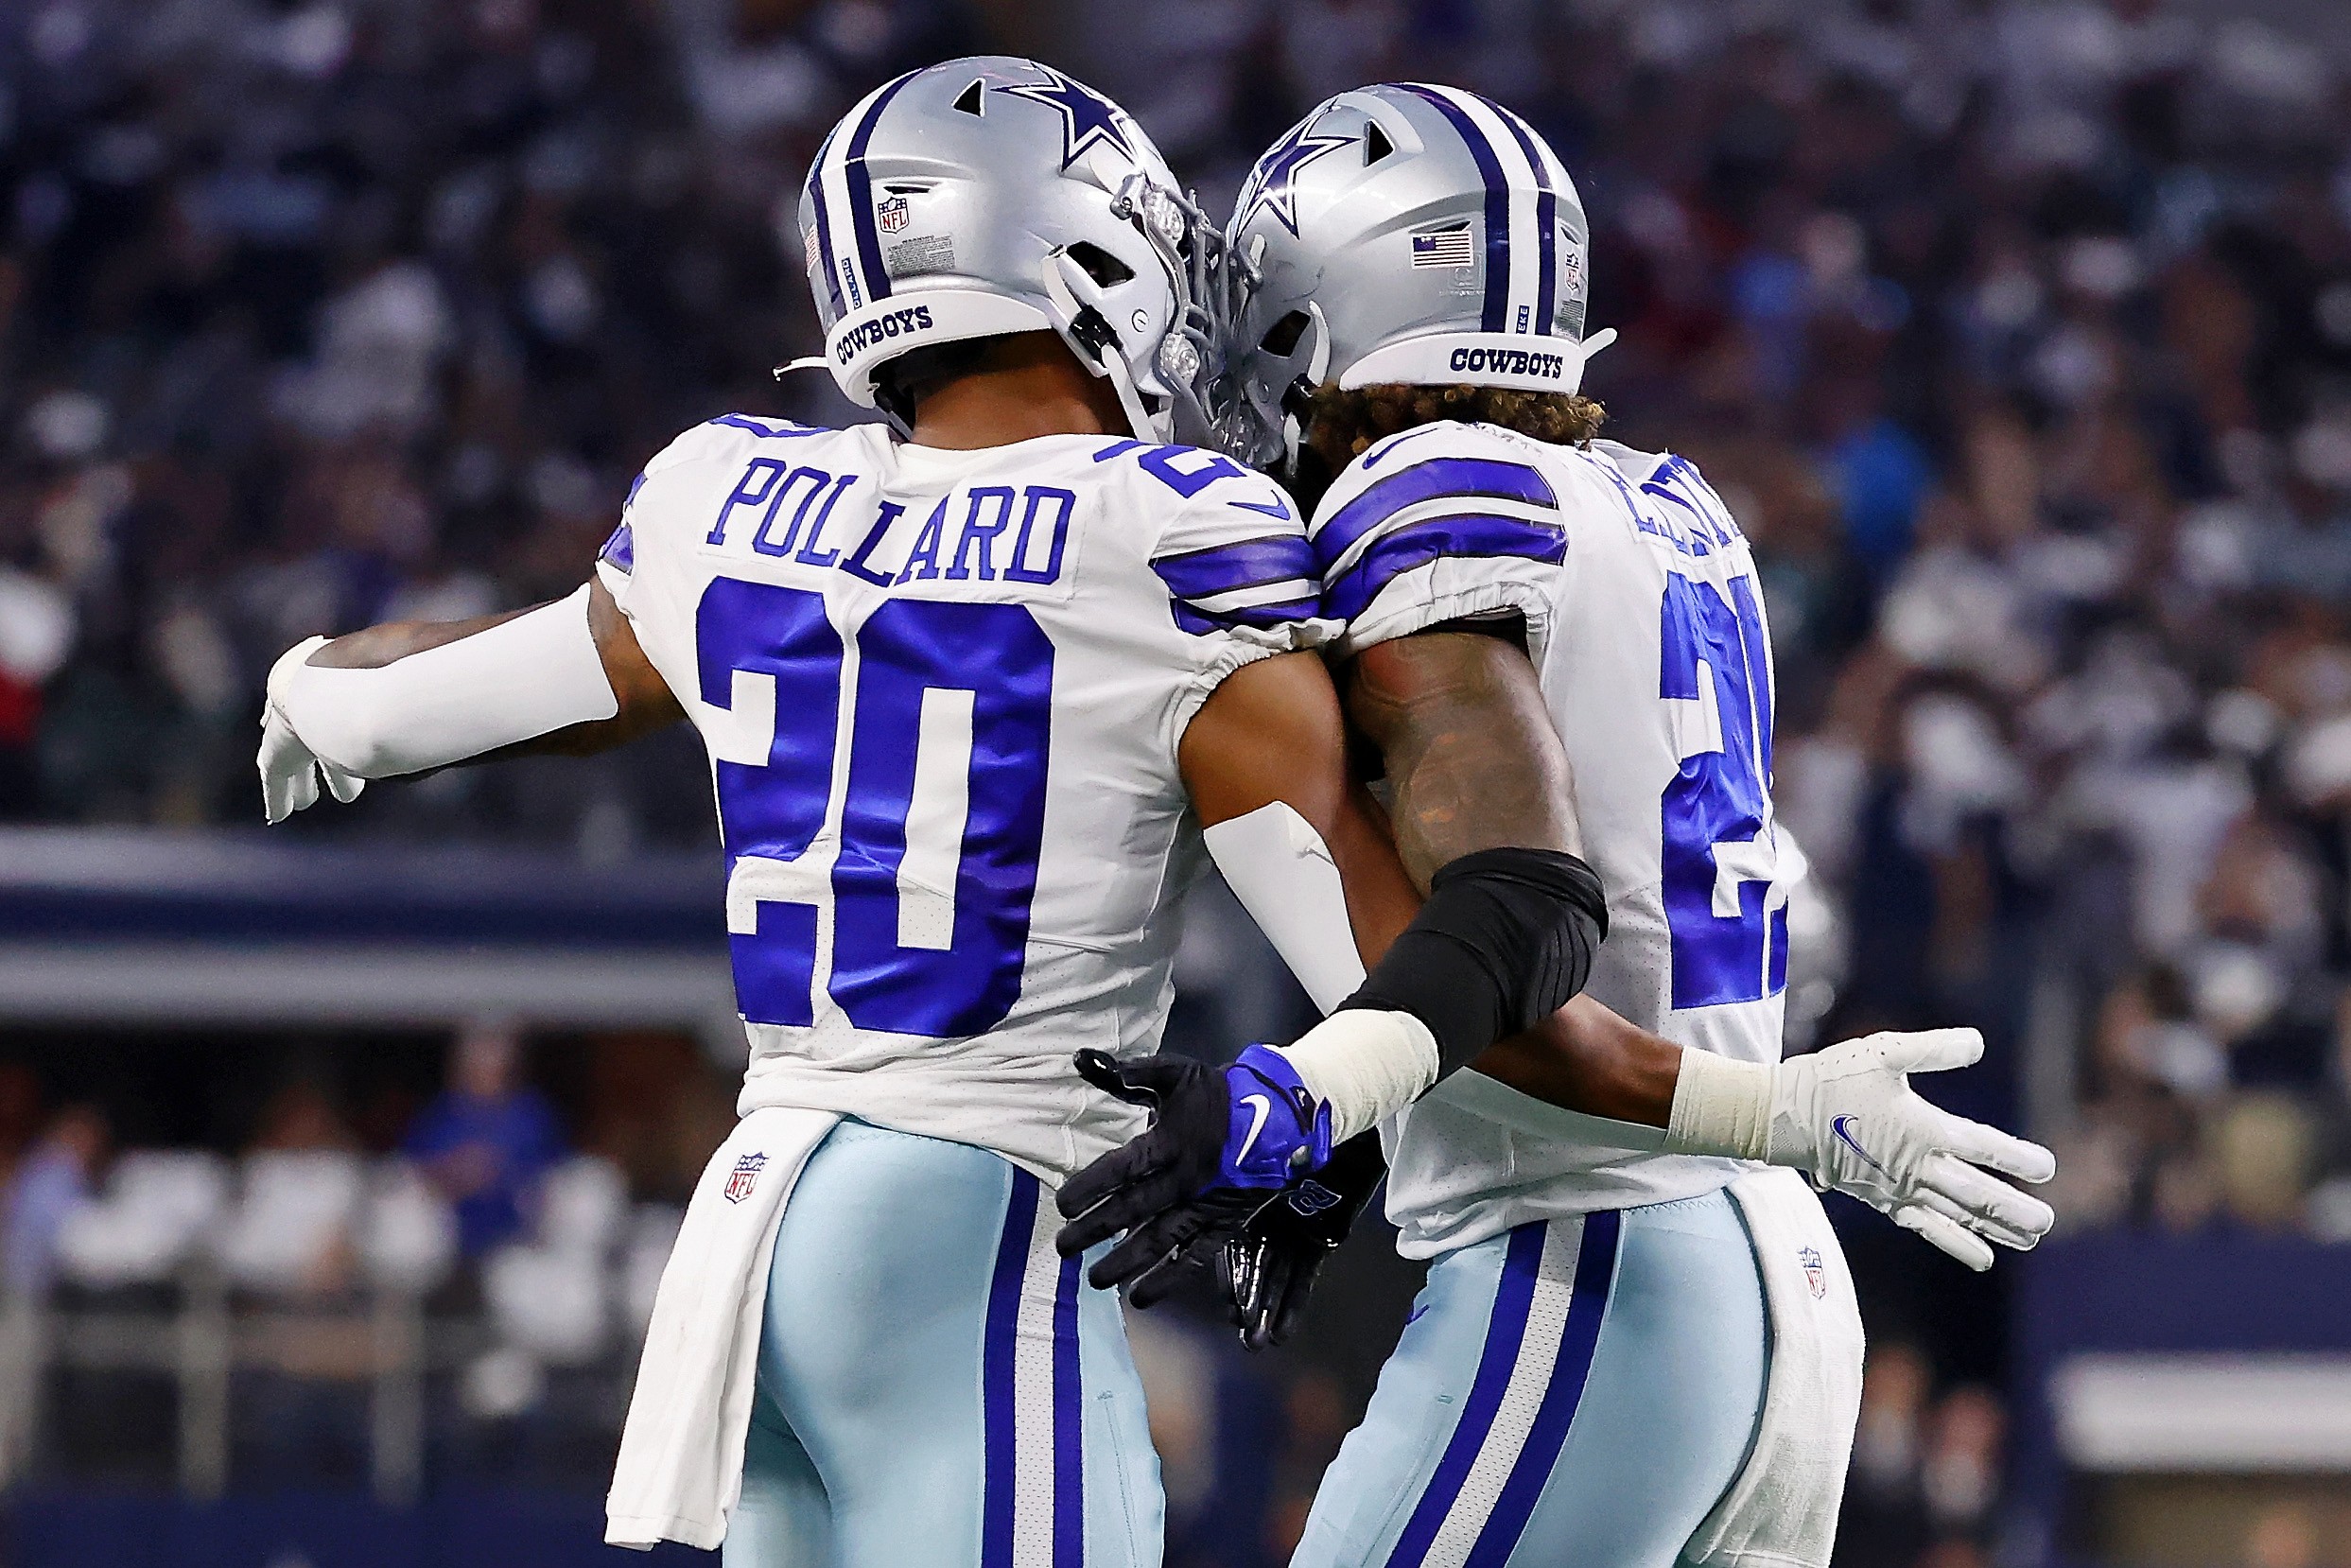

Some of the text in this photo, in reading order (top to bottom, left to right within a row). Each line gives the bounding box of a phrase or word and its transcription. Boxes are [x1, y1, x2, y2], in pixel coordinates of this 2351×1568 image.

[882, 211, 907, 229] NFL
[836, 305, 932, 365] COWBOYS
[1517, 306, 1528, 334] EKE
[1450, 348, 1563, 379] COWBOYS
[706, 457, 1076, 586] POLLARD
[696, 575, 1055, 1038] 20
[726, 1172, 755, 1198] NFL
